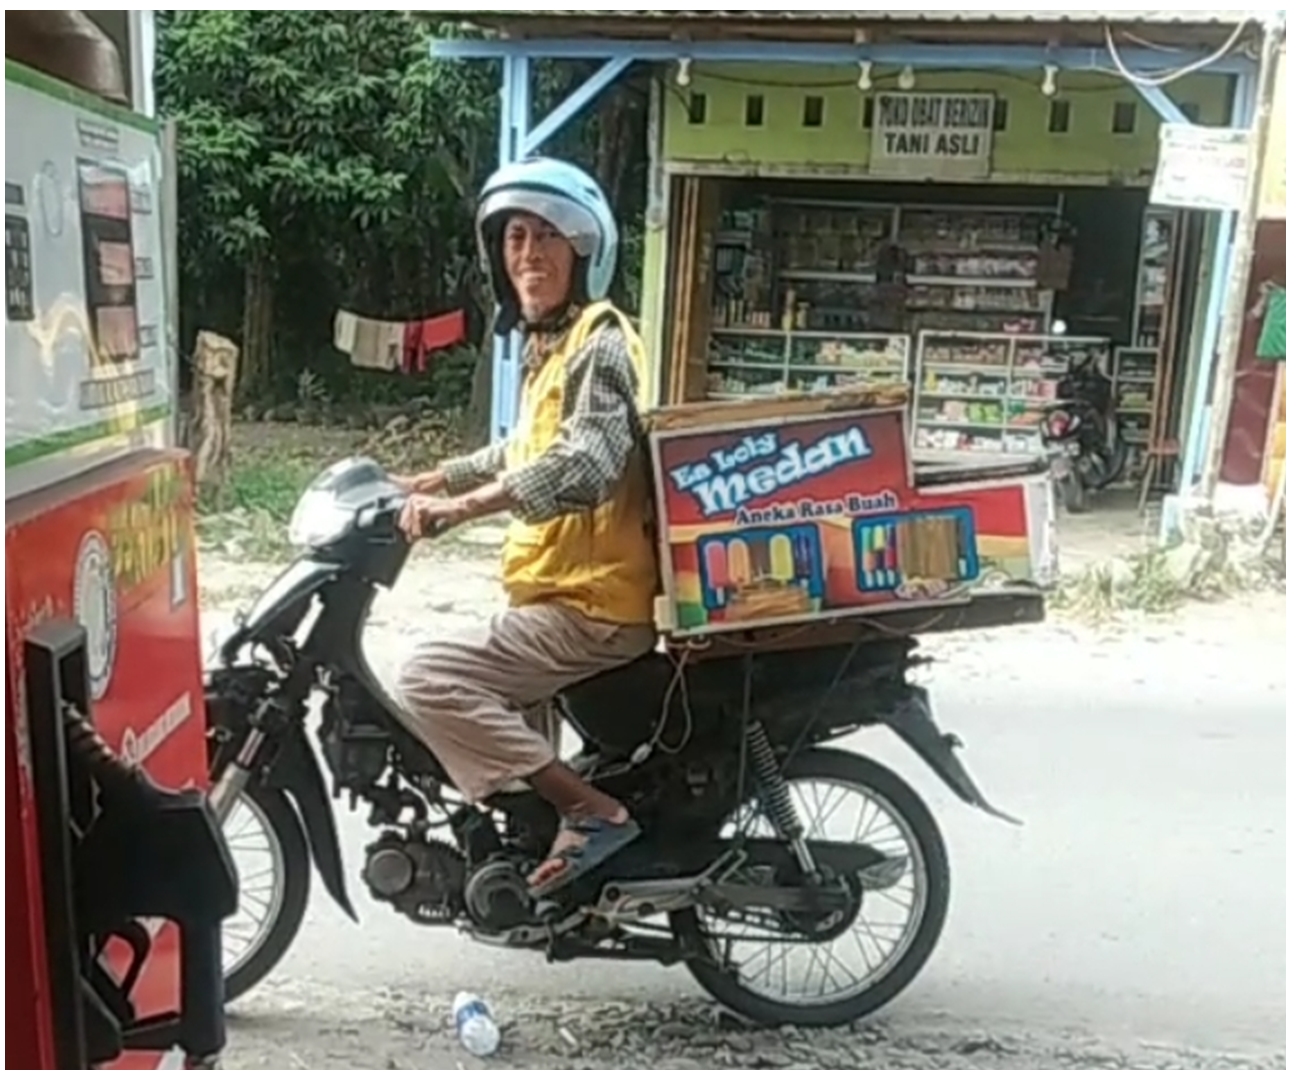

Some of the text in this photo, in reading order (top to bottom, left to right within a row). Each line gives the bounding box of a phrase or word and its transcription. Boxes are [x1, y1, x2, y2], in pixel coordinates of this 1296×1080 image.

[885, 133, 980, 155] TANI ASLI
[711, 432, 778, 472] Loly
[692, 427, 871, 515] Medan
[736, 492, 896, 526] Aneka Rasa Buah
